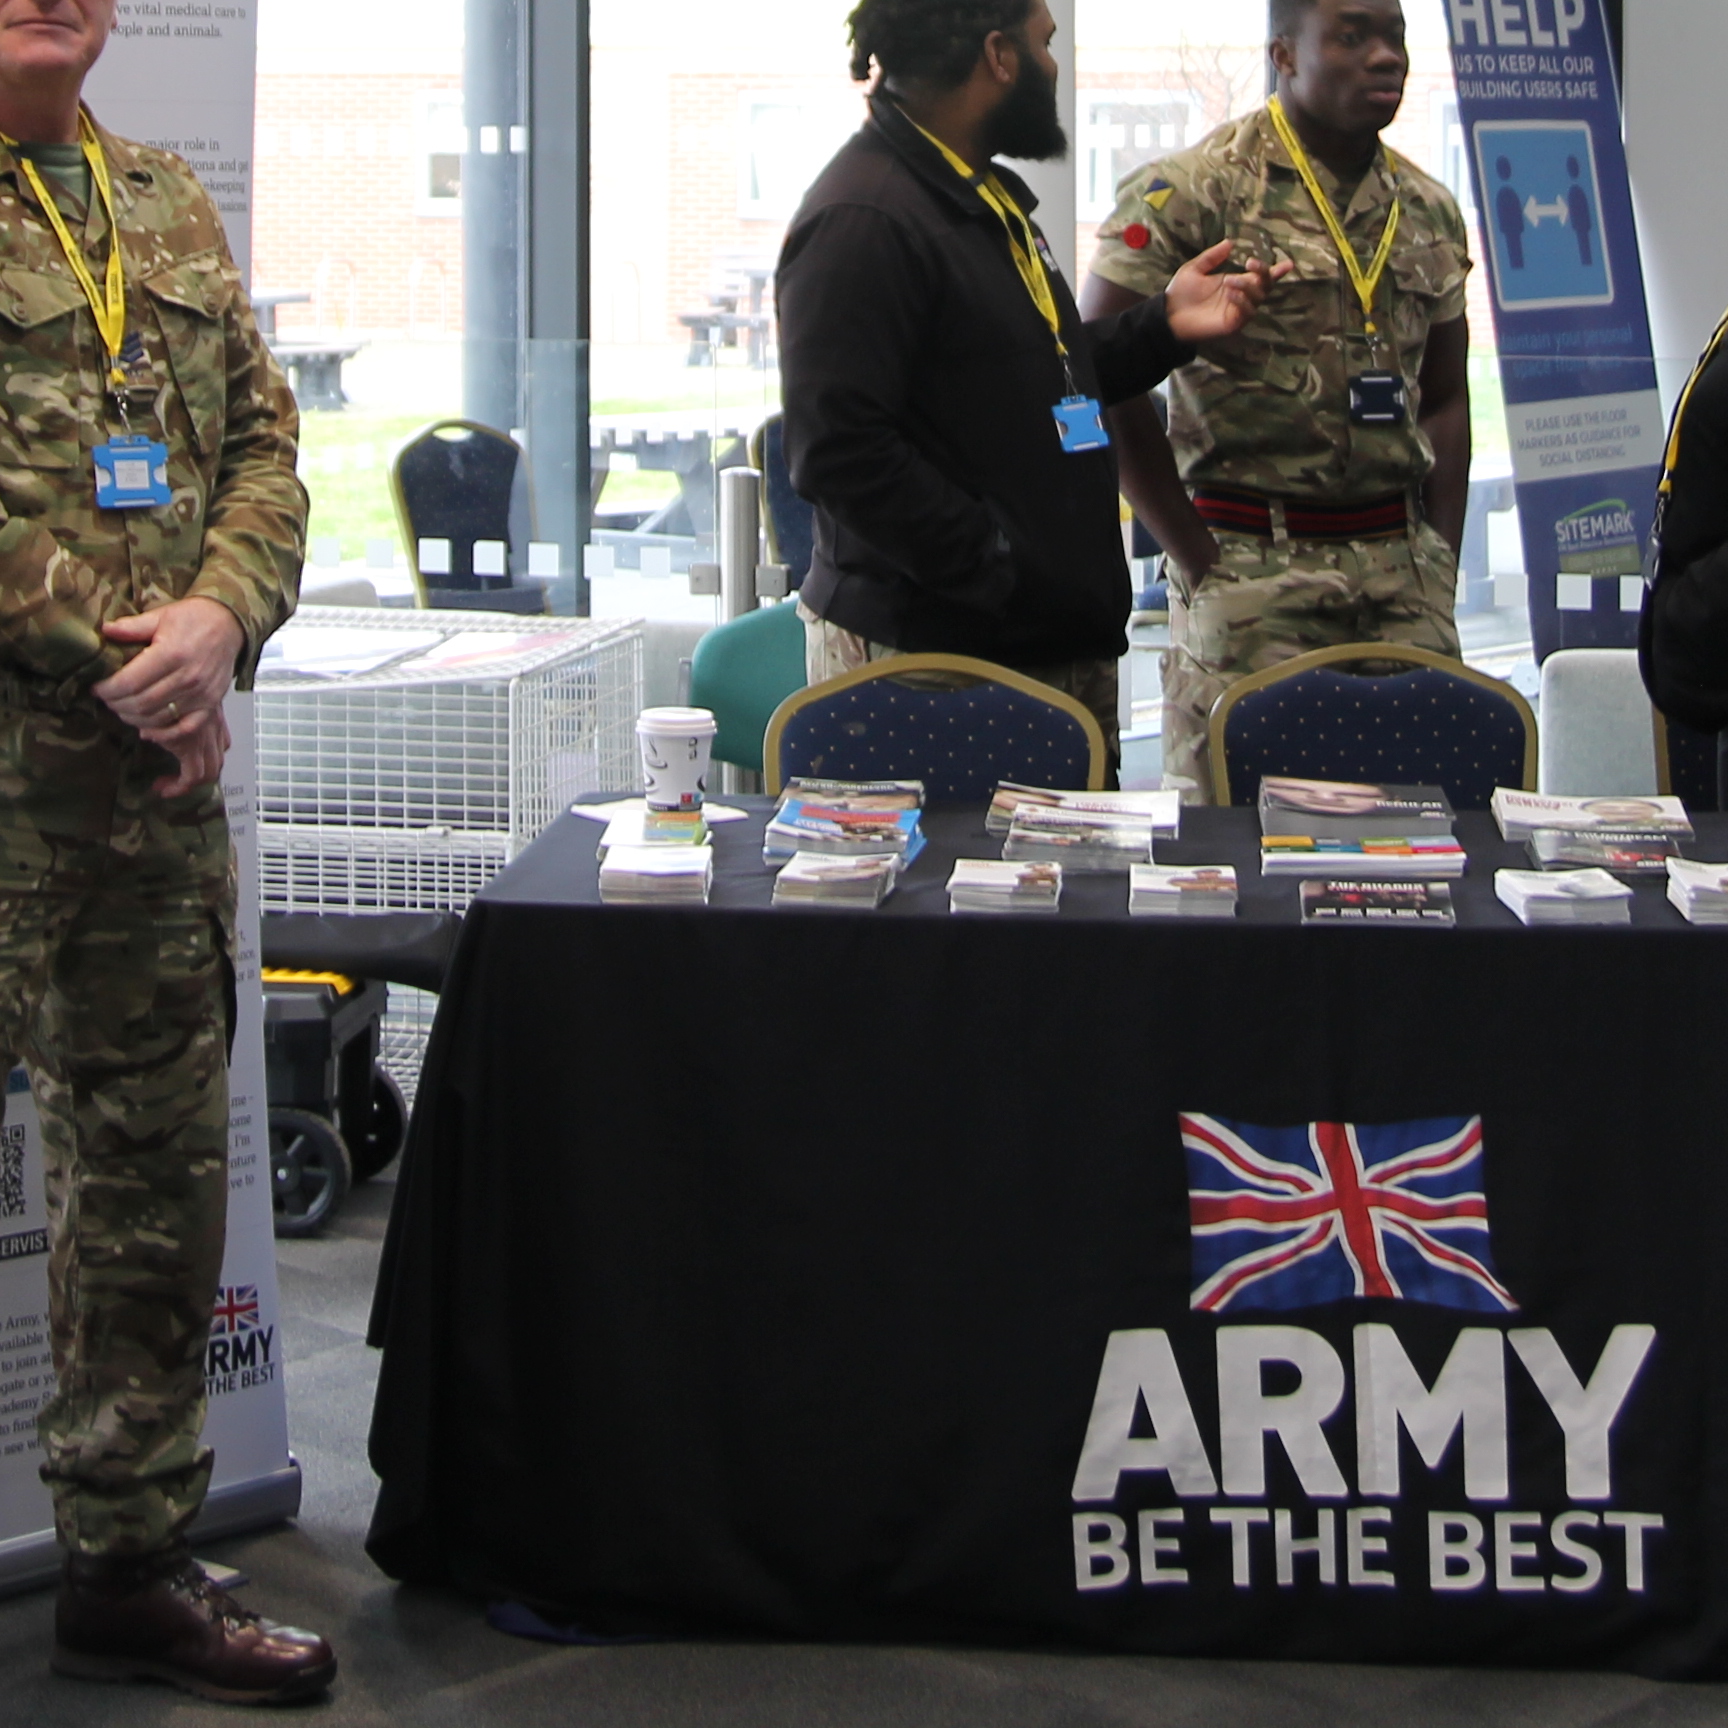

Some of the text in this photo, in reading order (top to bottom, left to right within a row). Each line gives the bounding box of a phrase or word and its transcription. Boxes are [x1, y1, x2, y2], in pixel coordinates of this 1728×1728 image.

[134, 1, 162, 16] vital
[165, 1, 212, 17] medical
[214, 7, 235, 18] care
[1455, 54, 1594, 74] US TO KEEP ALL OUR
[1458, 79, 1598, 100] BUILDING USERS SAFE
[1526, 414, 1561, 432] PLEASE
[1563, 412, 1582, 428] USE
[1555, 511, 1634, 542] SITEMARK
[205, 1324, 273, 1377] RMY
[241, 1362, 275, 1389] BEST
[1072, 1322, 1656, 1501] ARMY
[1072, 1507, 1664, 1592] BE THE BEST
